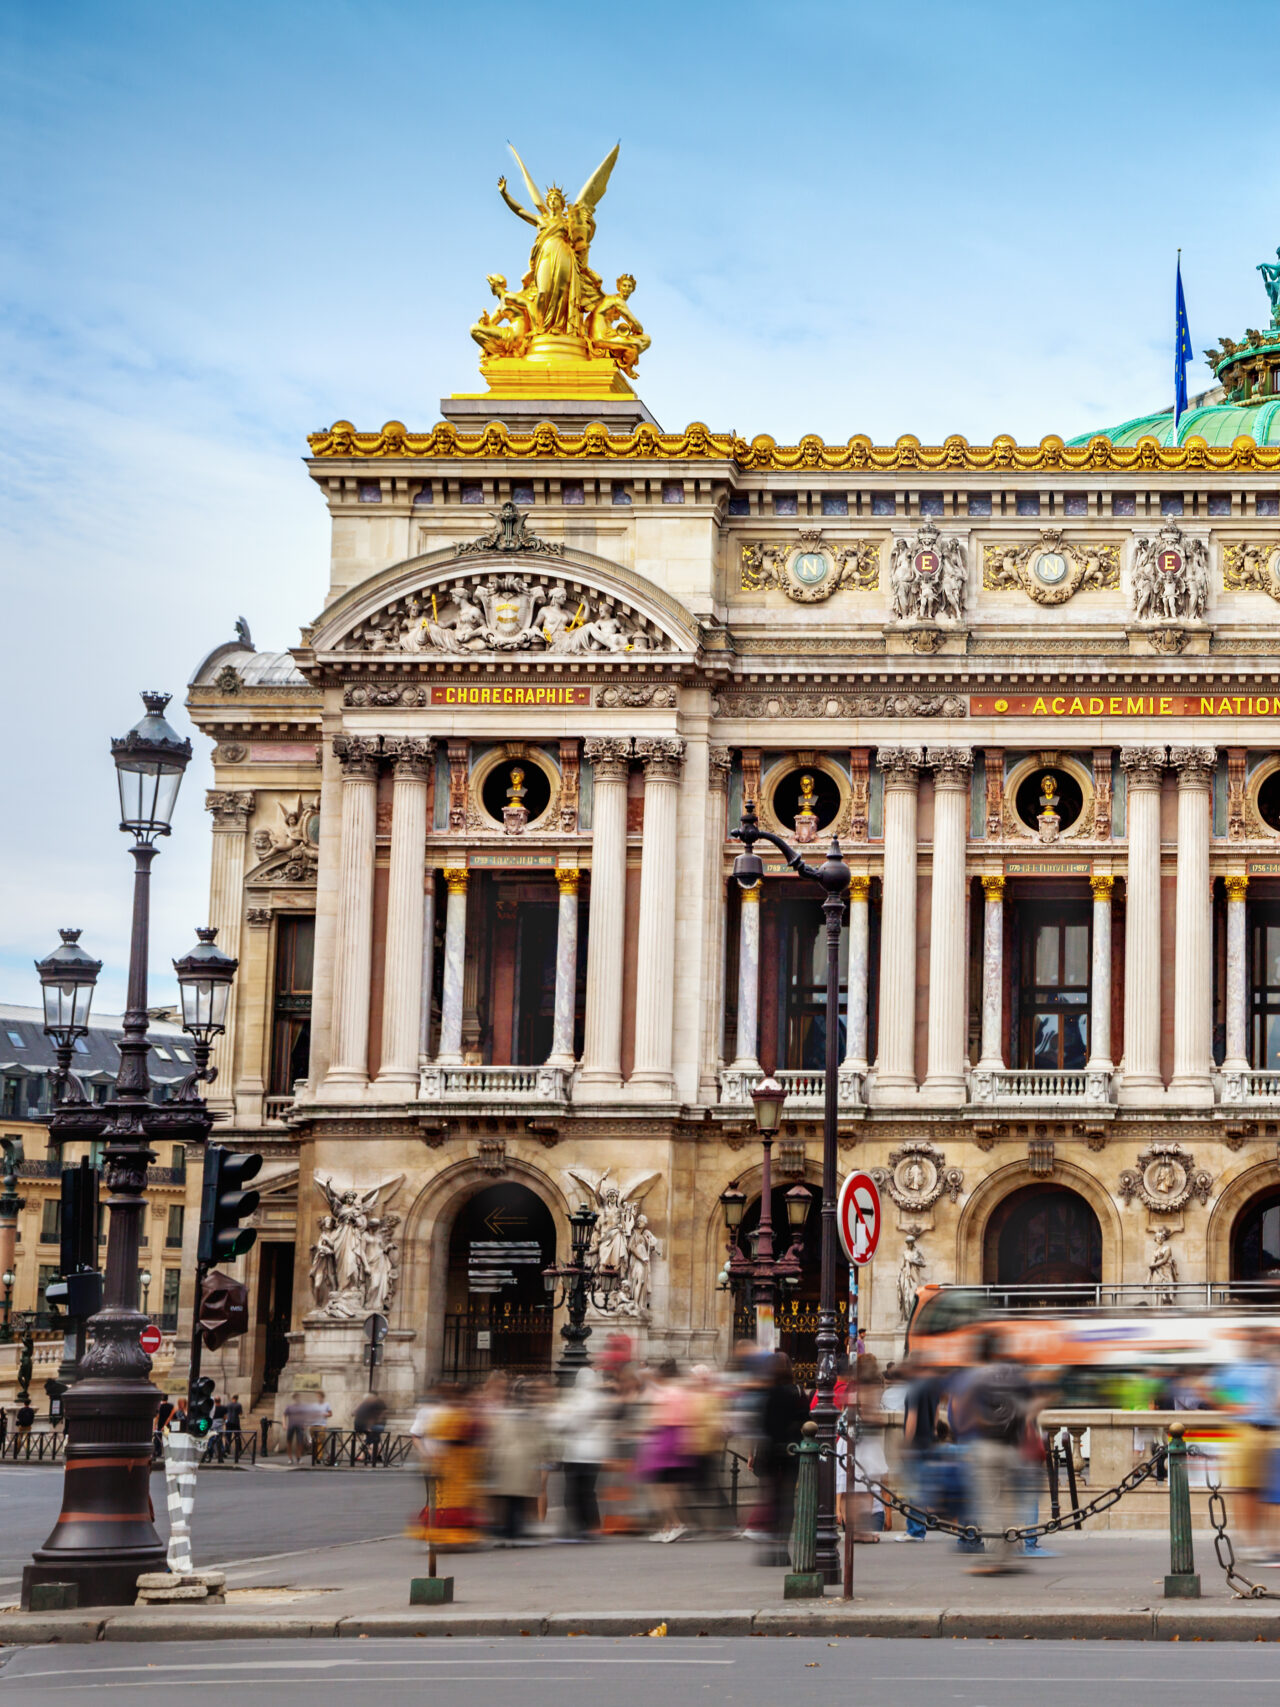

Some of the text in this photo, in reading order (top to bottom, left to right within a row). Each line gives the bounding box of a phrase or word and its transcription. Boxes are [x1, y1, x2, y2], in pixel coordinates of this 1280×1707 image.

[801, 559, 818, 576] N
[921, 555, 933, 571] E
[1043, 559, 1059, 576] N
[1164, 555, 1176, 570] E
[445, 687, 575, 704] CHOREGRAPHIE
[1032, 697, 1174, 715] ACADEMIE
[1252, 864, 1266, 872] 1756
